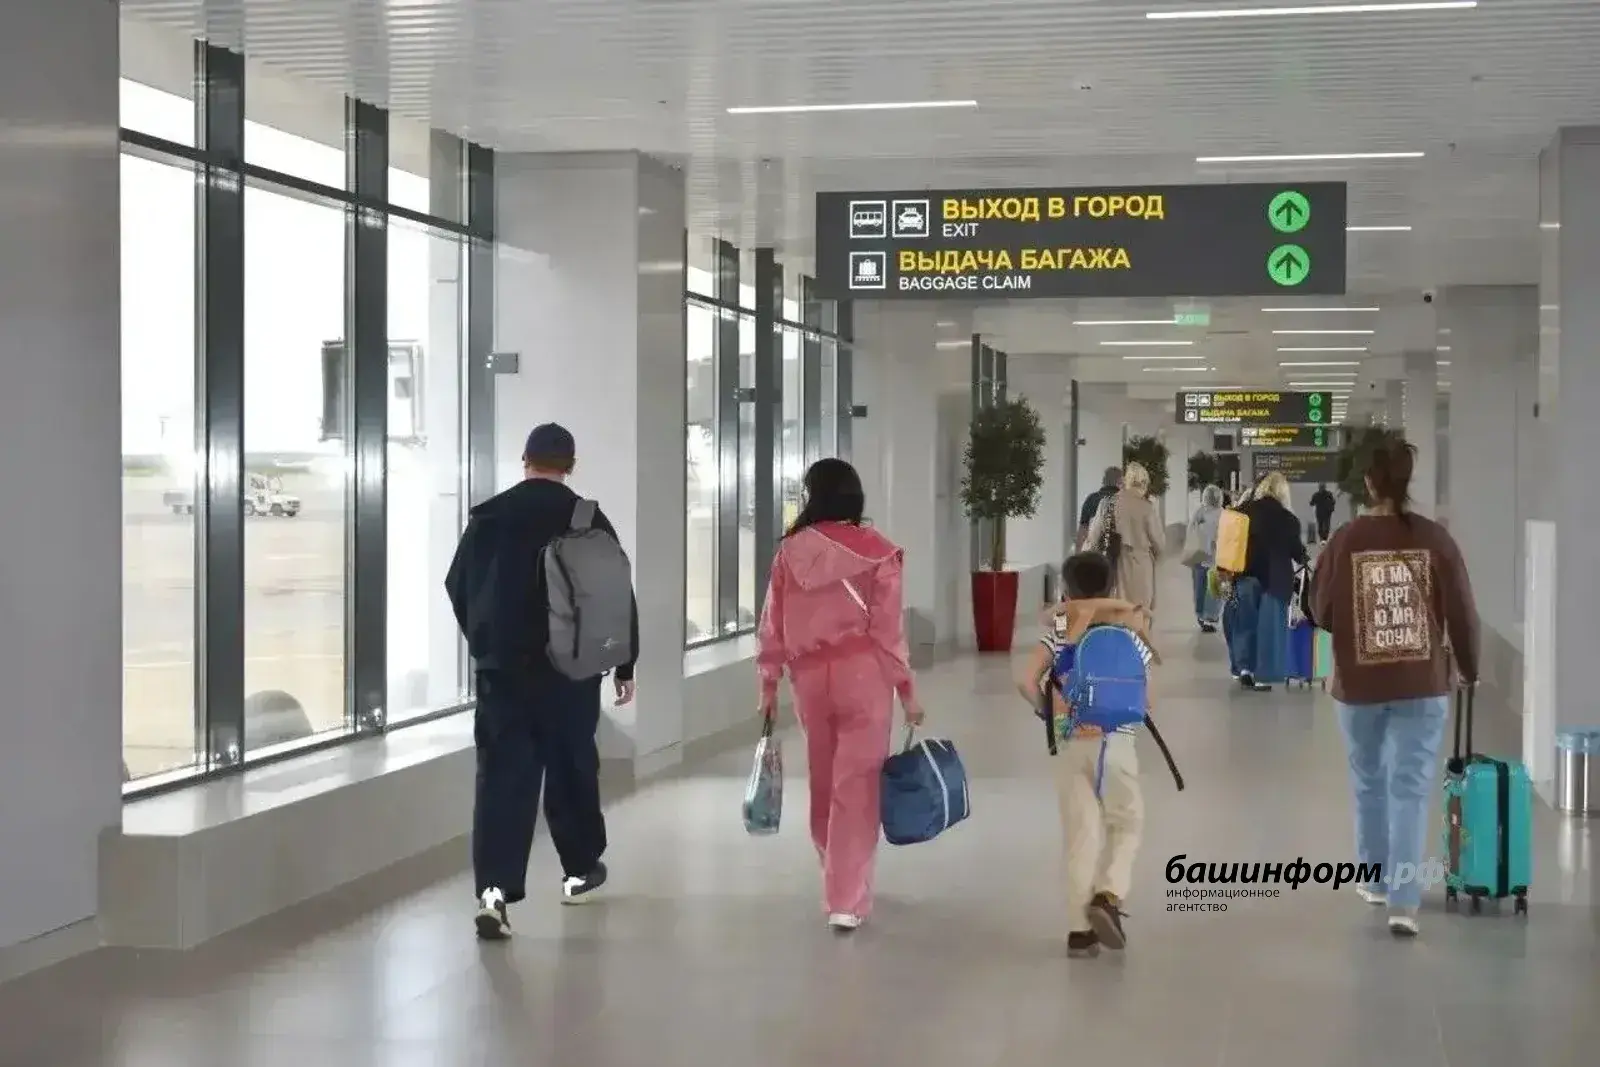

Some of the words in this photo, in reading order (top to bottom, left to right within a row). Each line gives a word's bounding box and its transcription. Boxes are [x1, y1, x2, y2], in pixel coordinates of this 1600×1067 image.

[943, 197, 1040, 221] ВЫХОД
[1048, 197, 1065, 218] В
[1074, 195, 1164, 219] ГОРОД
[943, 223, 979, 237] EXIT
[899, 250, 1013, 275] ВЫДАЧА
[1020, 248, 1131, 270] БАГАЖА
[899, 276, 978, 290] BAGGAGE
[982, 275, 1031, 289] CLAIM
[1375, 586, 1410, 605] ХАРТ
[1375, 627, 1414, 647] СОУЛ
